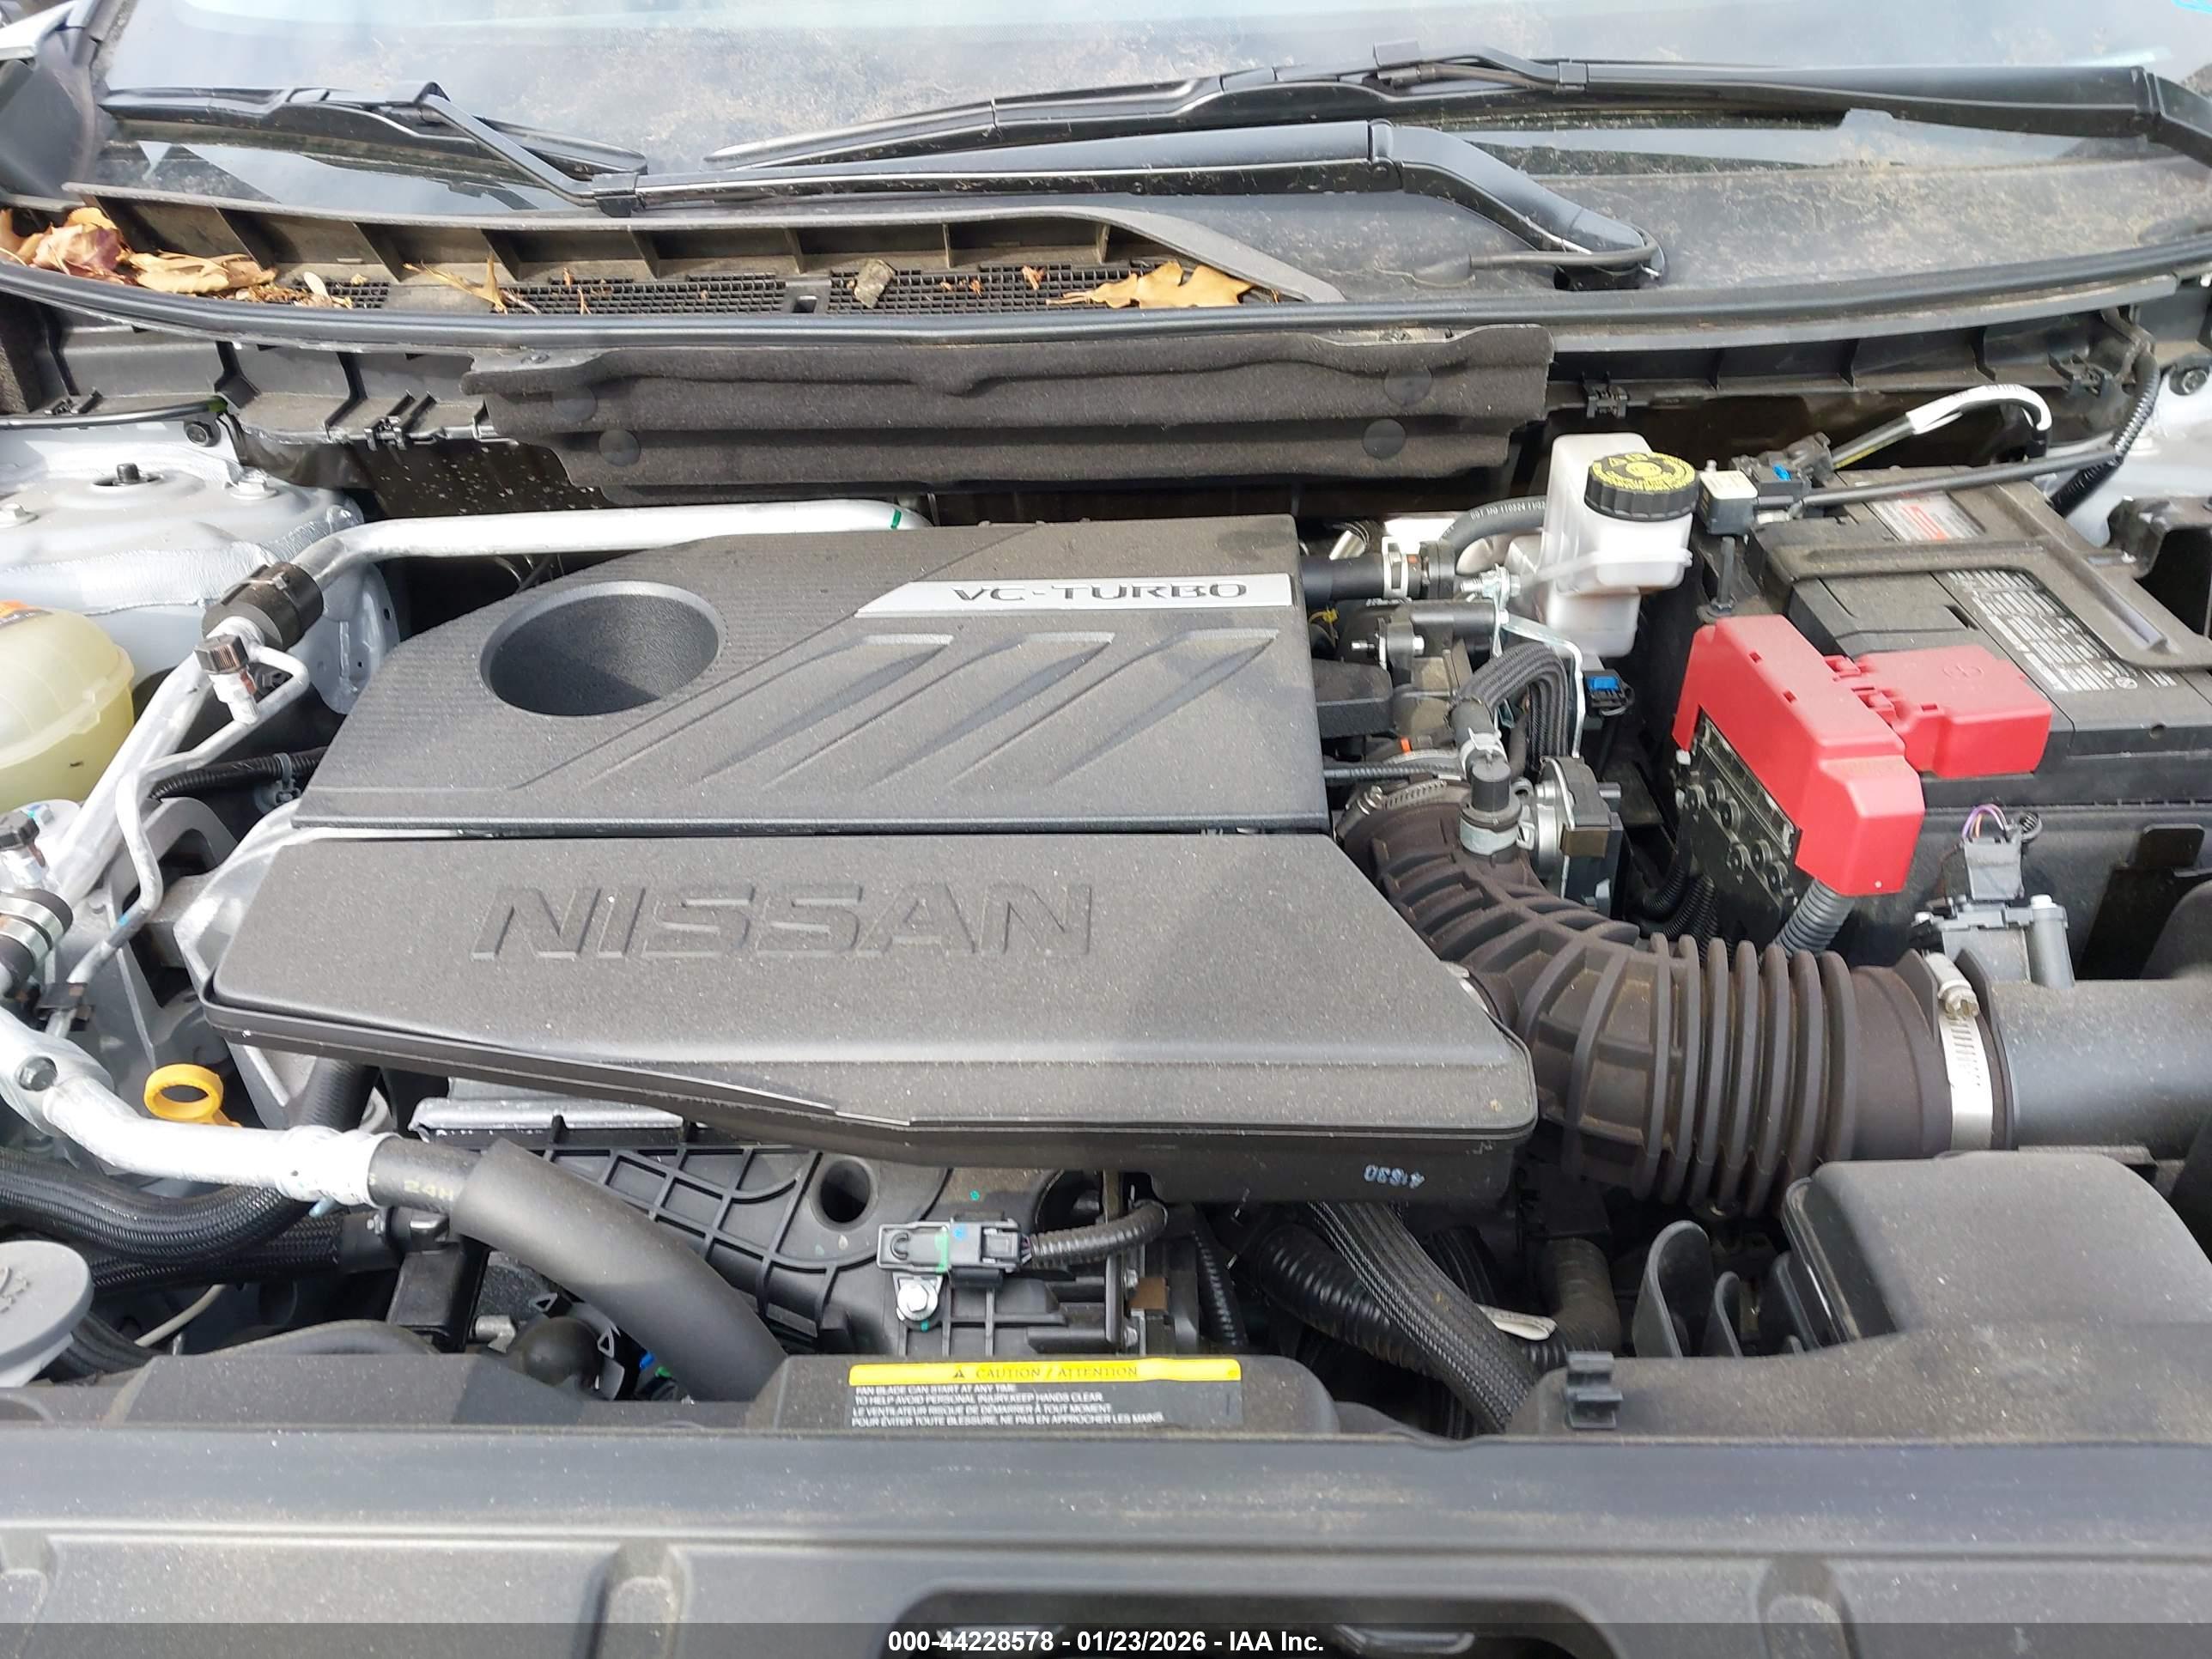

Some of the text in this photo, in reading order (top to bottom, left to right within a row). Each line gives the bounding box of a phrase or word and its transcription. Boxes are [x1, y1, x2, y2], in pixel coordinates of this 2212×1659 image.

[951, 583, 1248, 602] VC-TURBO
[469, 883, 1093, 960] NISSAN
[975, 1368, 1041, 1379] CAUTION
[1058, 1366, 1138, 1377] ATTENTION
[856, 1386, 874, 1395] FAN
[876, 1386, 907, 1395] BLADE
[908, 1385, 928, 1395] CAN
[931, 1385, 958, 1395] START
[960, 1384, 972, 1394] AT
[974, 1384, 994, 1393] ANY
[855, 1395, 868, 1406] TO
[869, 1395, 895, 1405] HELP
[896, 1395, 924, 1405] AVOID
[926, 1394, 975, 1404] PERSONAL
[1036, 1392, 1070, 1402] HANDS
[853, 1407, 866, 1417] LE
[866, 1406, 927, 1416] VENTILATEUR
[928, 1405, 964, 1415] RISQUE
[966, 1405, 979, 1415] DE
[1043, 1403, 1068, 1413] TOUT
[852, 1418, 880, 1427] POUR
[915, 1416, 945, 1426] TOUTE
[1000, 1414, 1013, 1425] NE
[1015, 1414, 1035, 1425] PAS
[1036, 1414, 1050, 1425] EN
[1051, 1413, 1111, 1425] APPROCHER
[1112, 1413, 1131, 1424] LES
